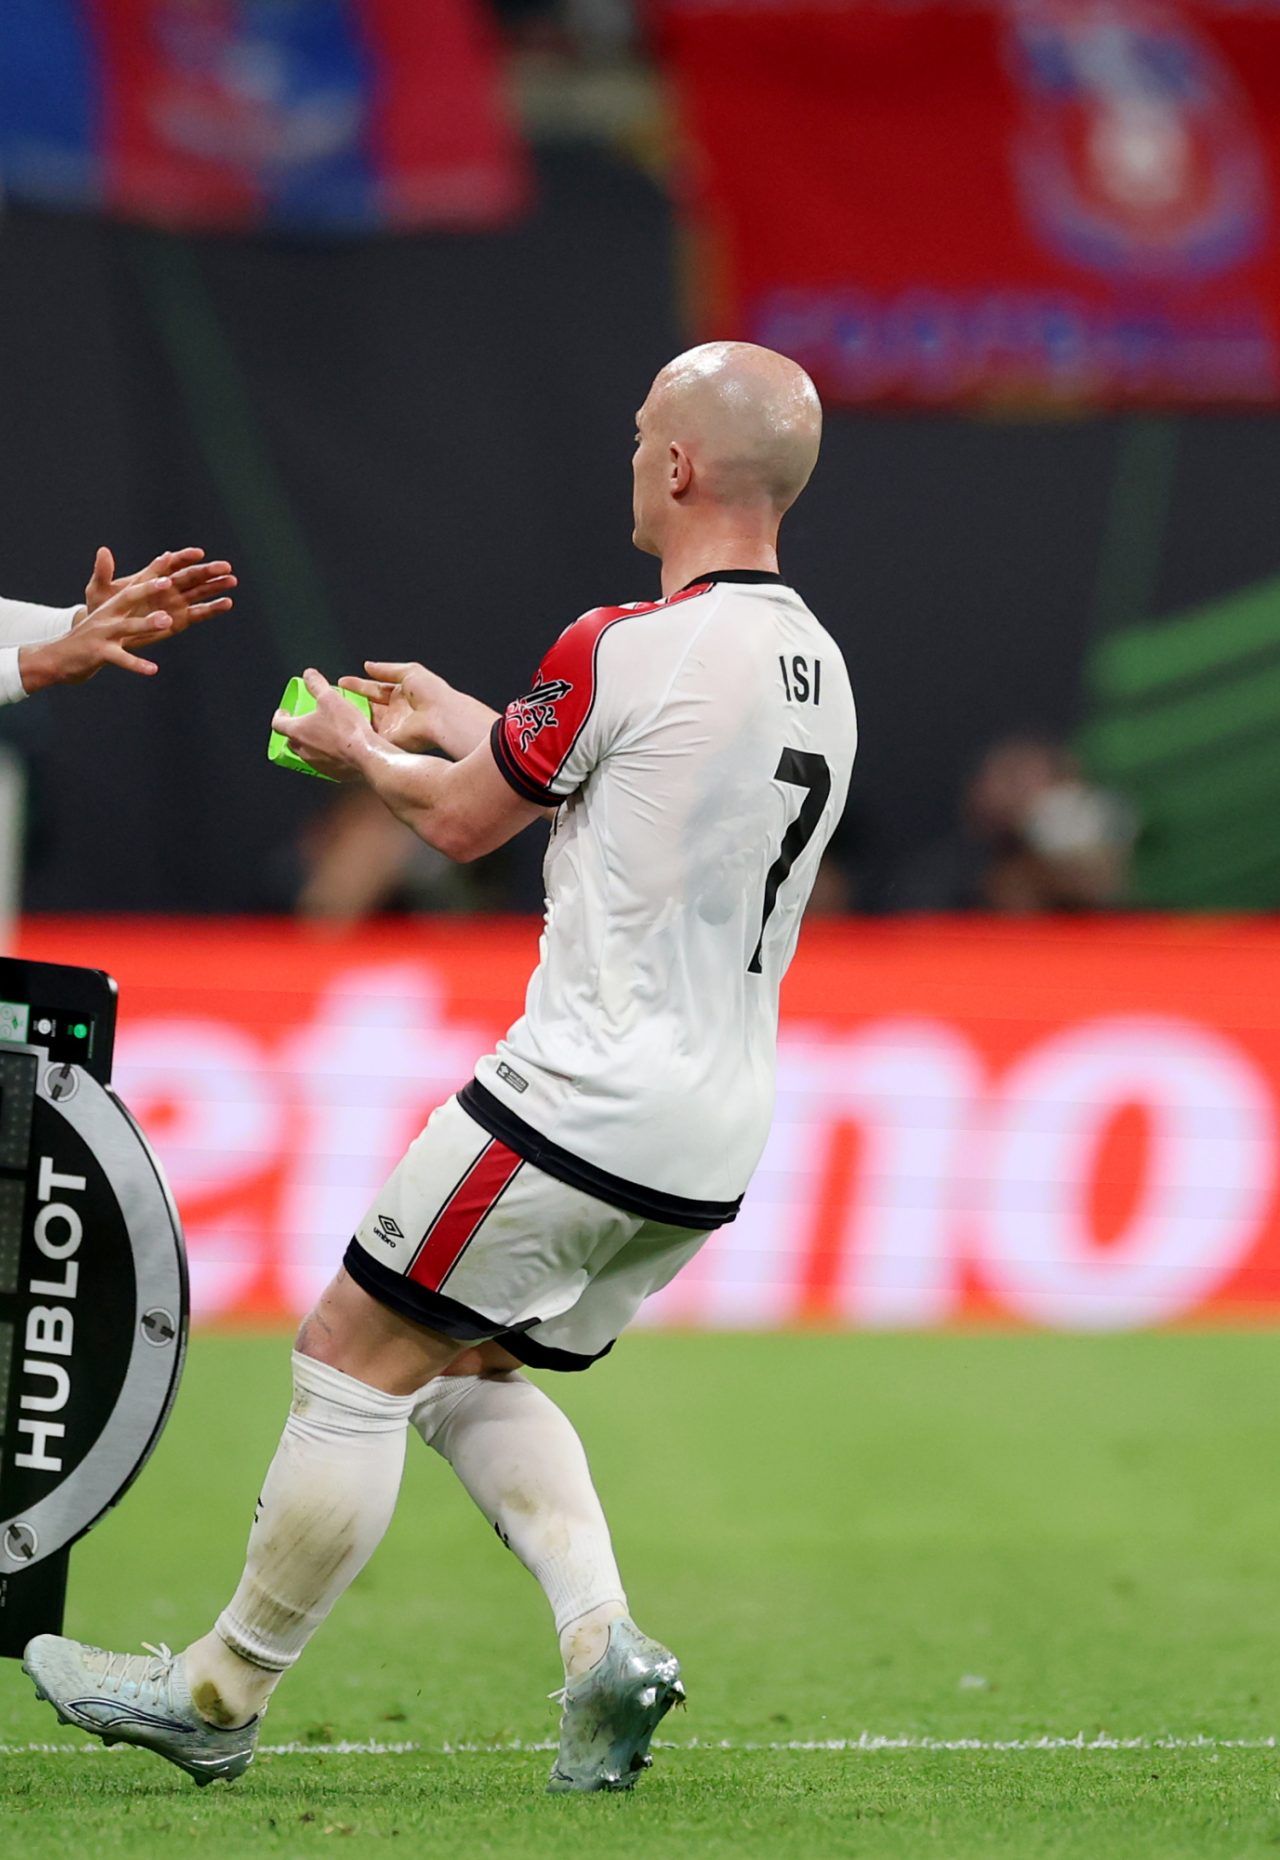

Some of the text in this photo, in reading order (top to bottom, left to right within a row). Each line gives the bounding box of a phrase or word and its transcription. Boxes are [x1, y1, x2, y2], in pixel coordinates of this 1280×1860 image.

[778, 655, 821, 706] ISI
[747, 746, 832, 974] 7
[373, 1226, 397, 1249] umbro
[14, 1156, 87, 1472] HUBLOT
